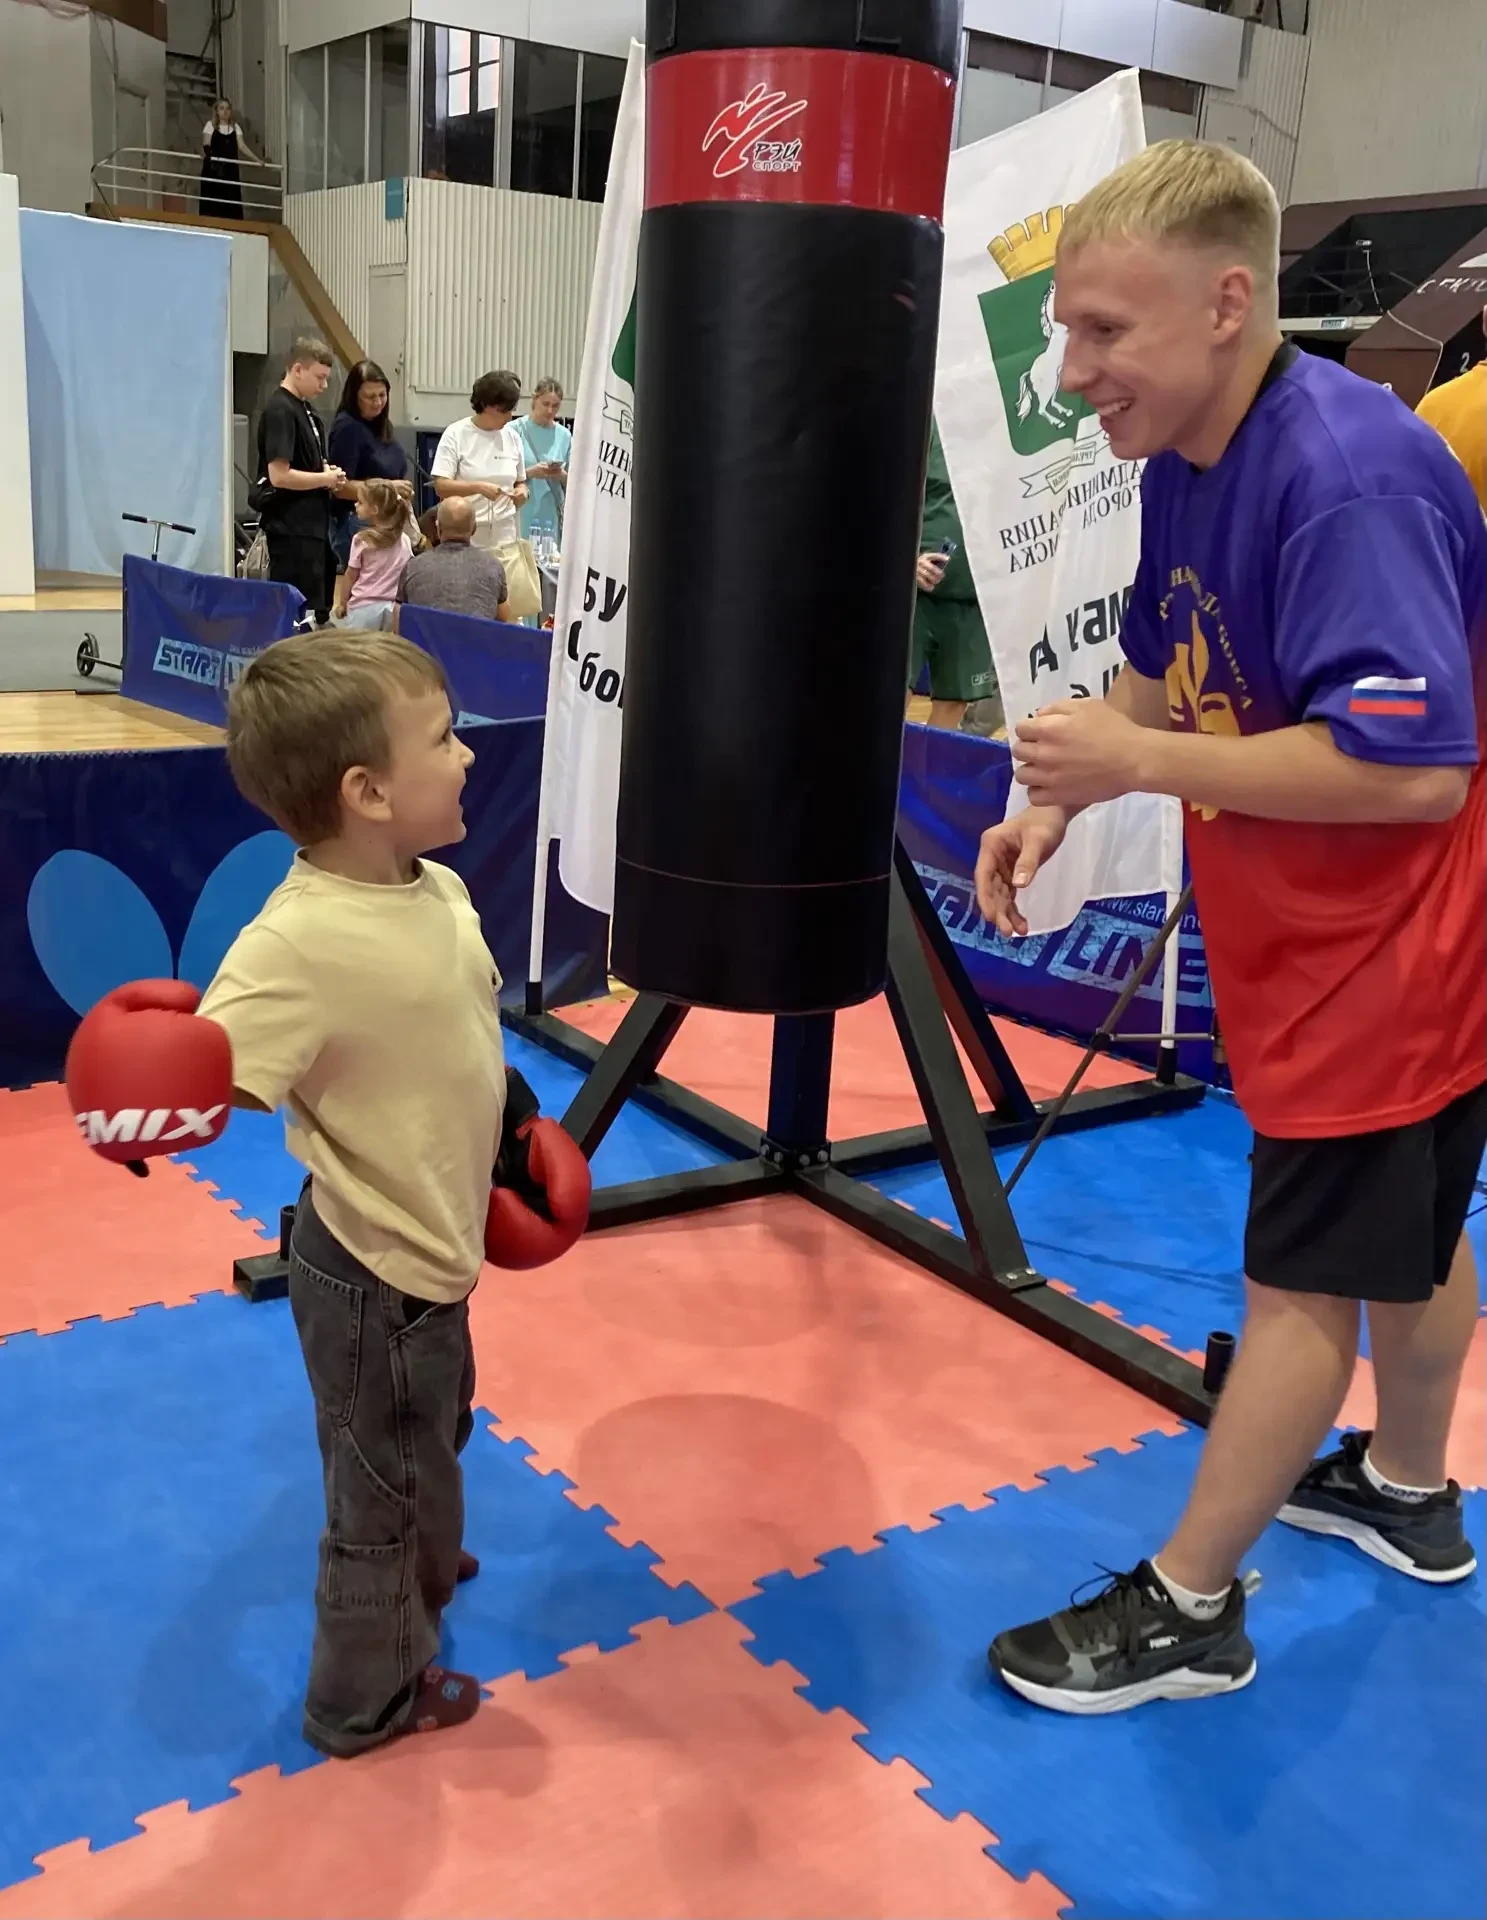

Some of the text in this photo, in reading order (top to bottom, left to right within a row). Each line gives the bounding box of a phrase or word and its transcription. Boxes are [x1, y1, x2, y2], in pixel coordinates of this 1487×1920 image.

[753, 138, 802, 162] РЭЙ
[752, 159, 802, 172] СПОРТ
[579, 652, 625, 709] бо
